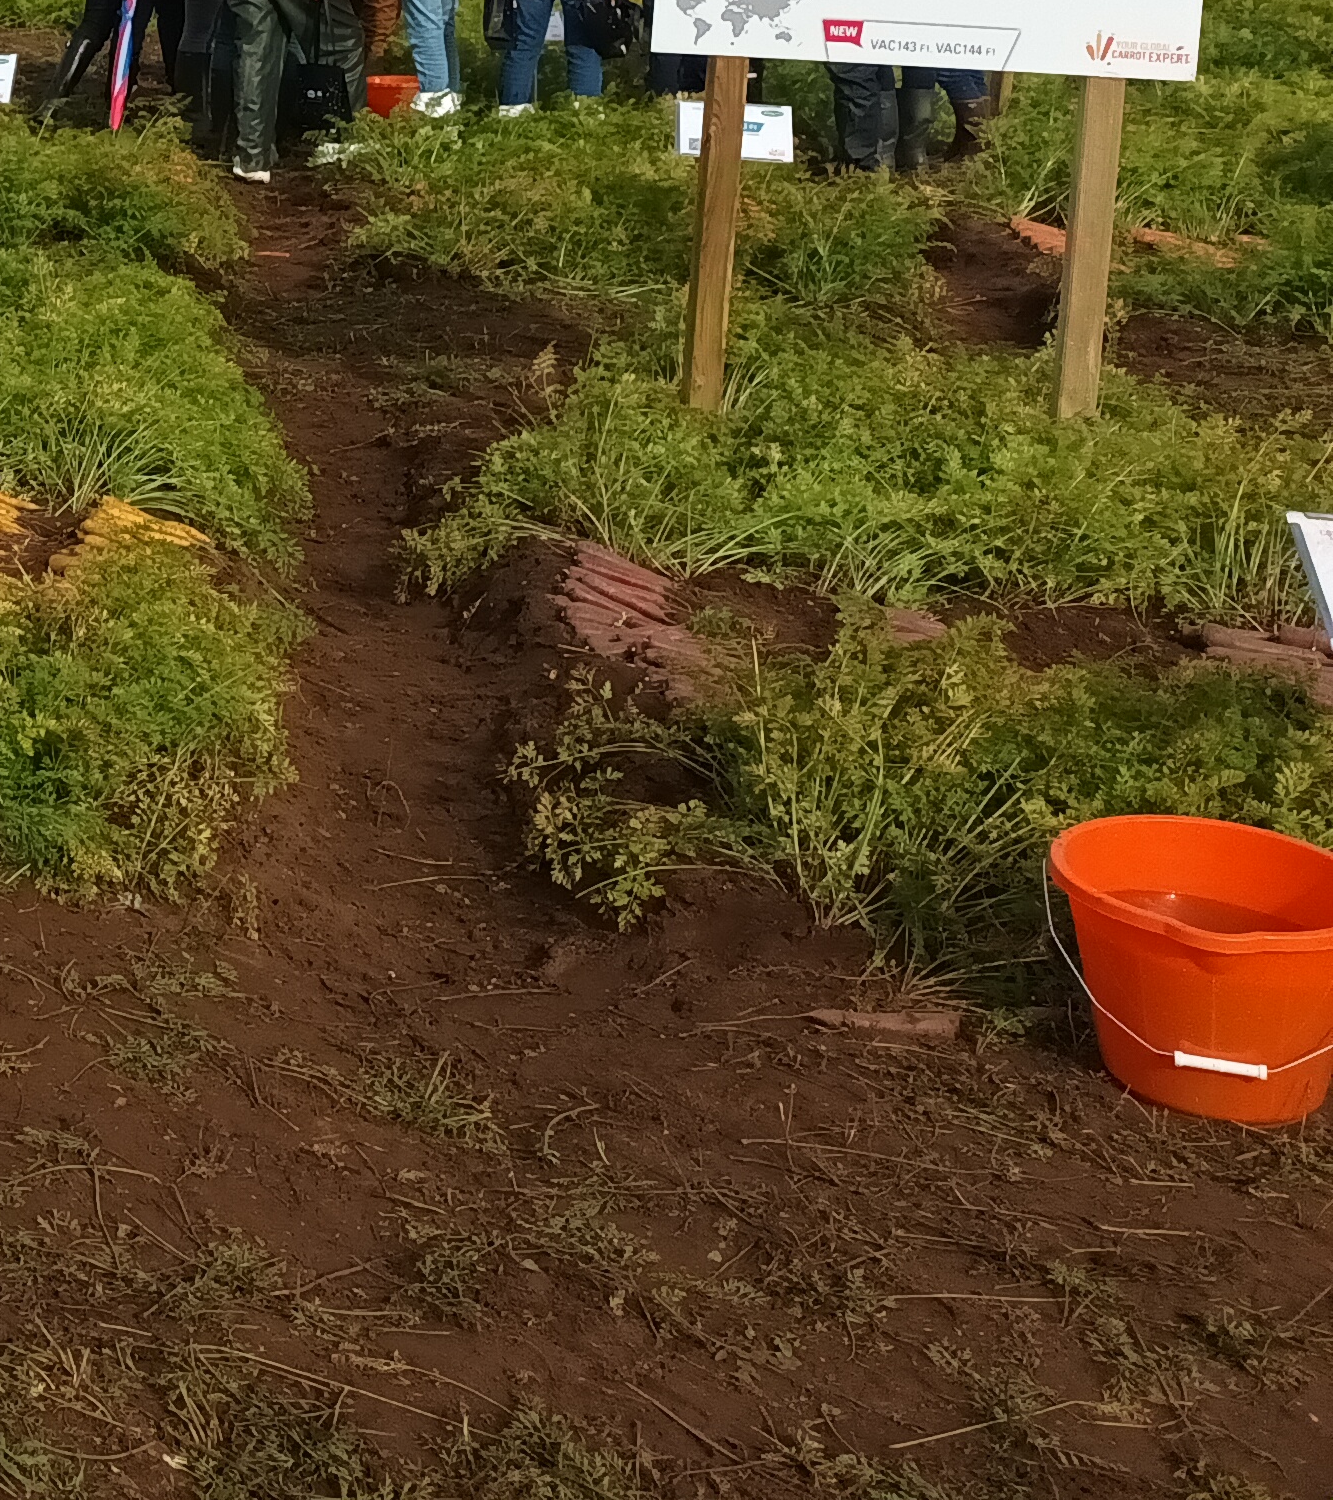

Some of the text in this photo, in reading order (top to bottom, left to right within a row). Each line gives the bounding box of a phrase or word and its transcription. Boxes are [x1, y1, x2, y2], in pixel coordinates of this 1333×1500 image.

[830, 25, 858, 37] NEW
[870, 39, 917, 52] VAC143
[936, 42, 982, 55] VAC144
[986, 48, 995, 56] F1
[1116, 41, 1171, 51] YOUR GLOBAL
[1112, 50, 1190, 64] CARROT EXPERT
